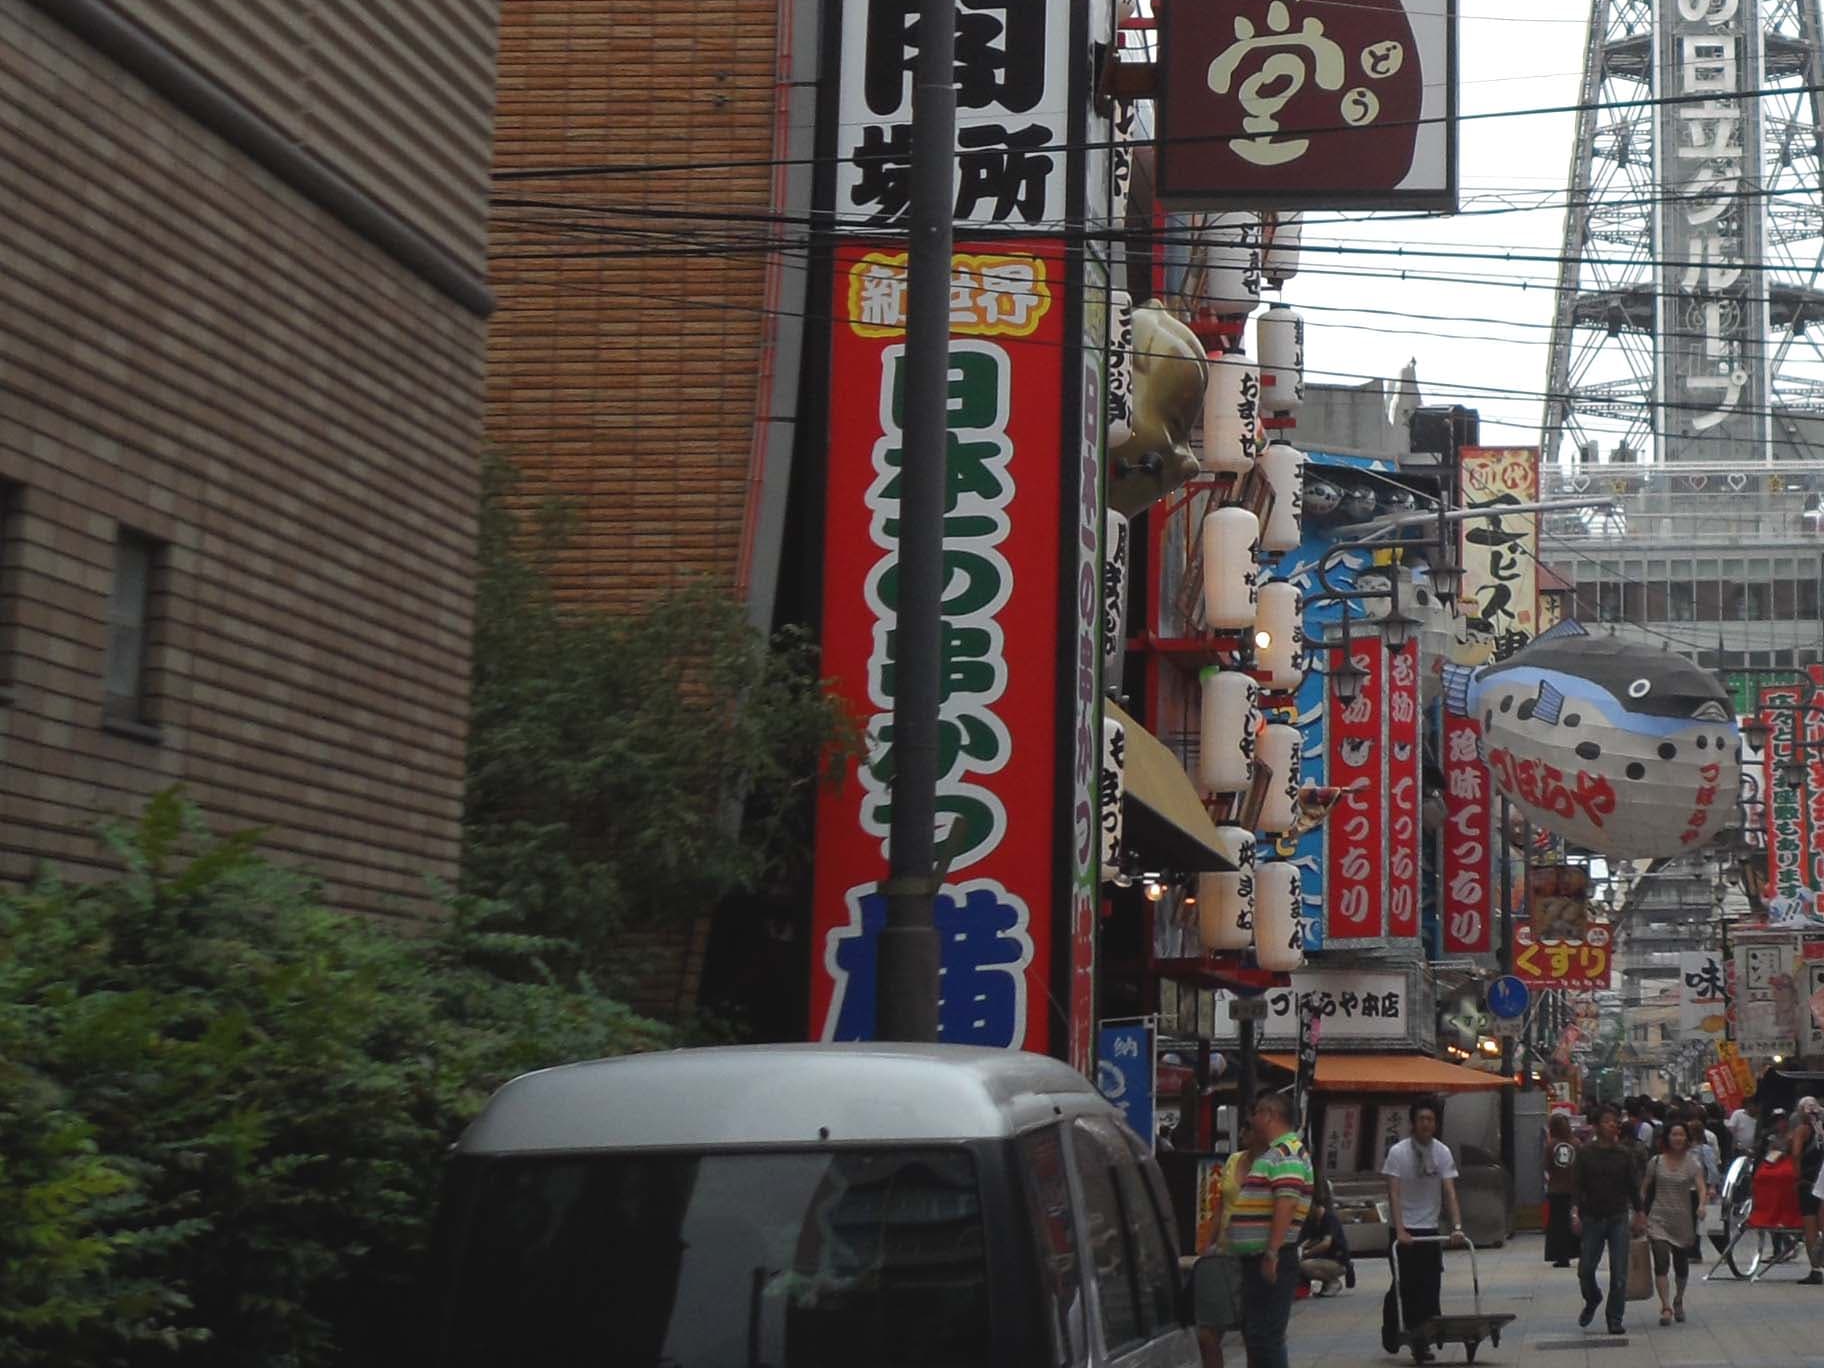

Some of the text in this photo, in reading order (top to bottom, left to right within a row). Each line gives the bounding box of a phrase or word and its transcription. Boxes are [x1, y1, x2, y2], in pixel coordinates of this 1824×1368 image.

[1339, 776, 1371, 922] てっちり
[1392, 776, 1413, 922] てっちり
[1516, 943, 1606, 978] くすり
